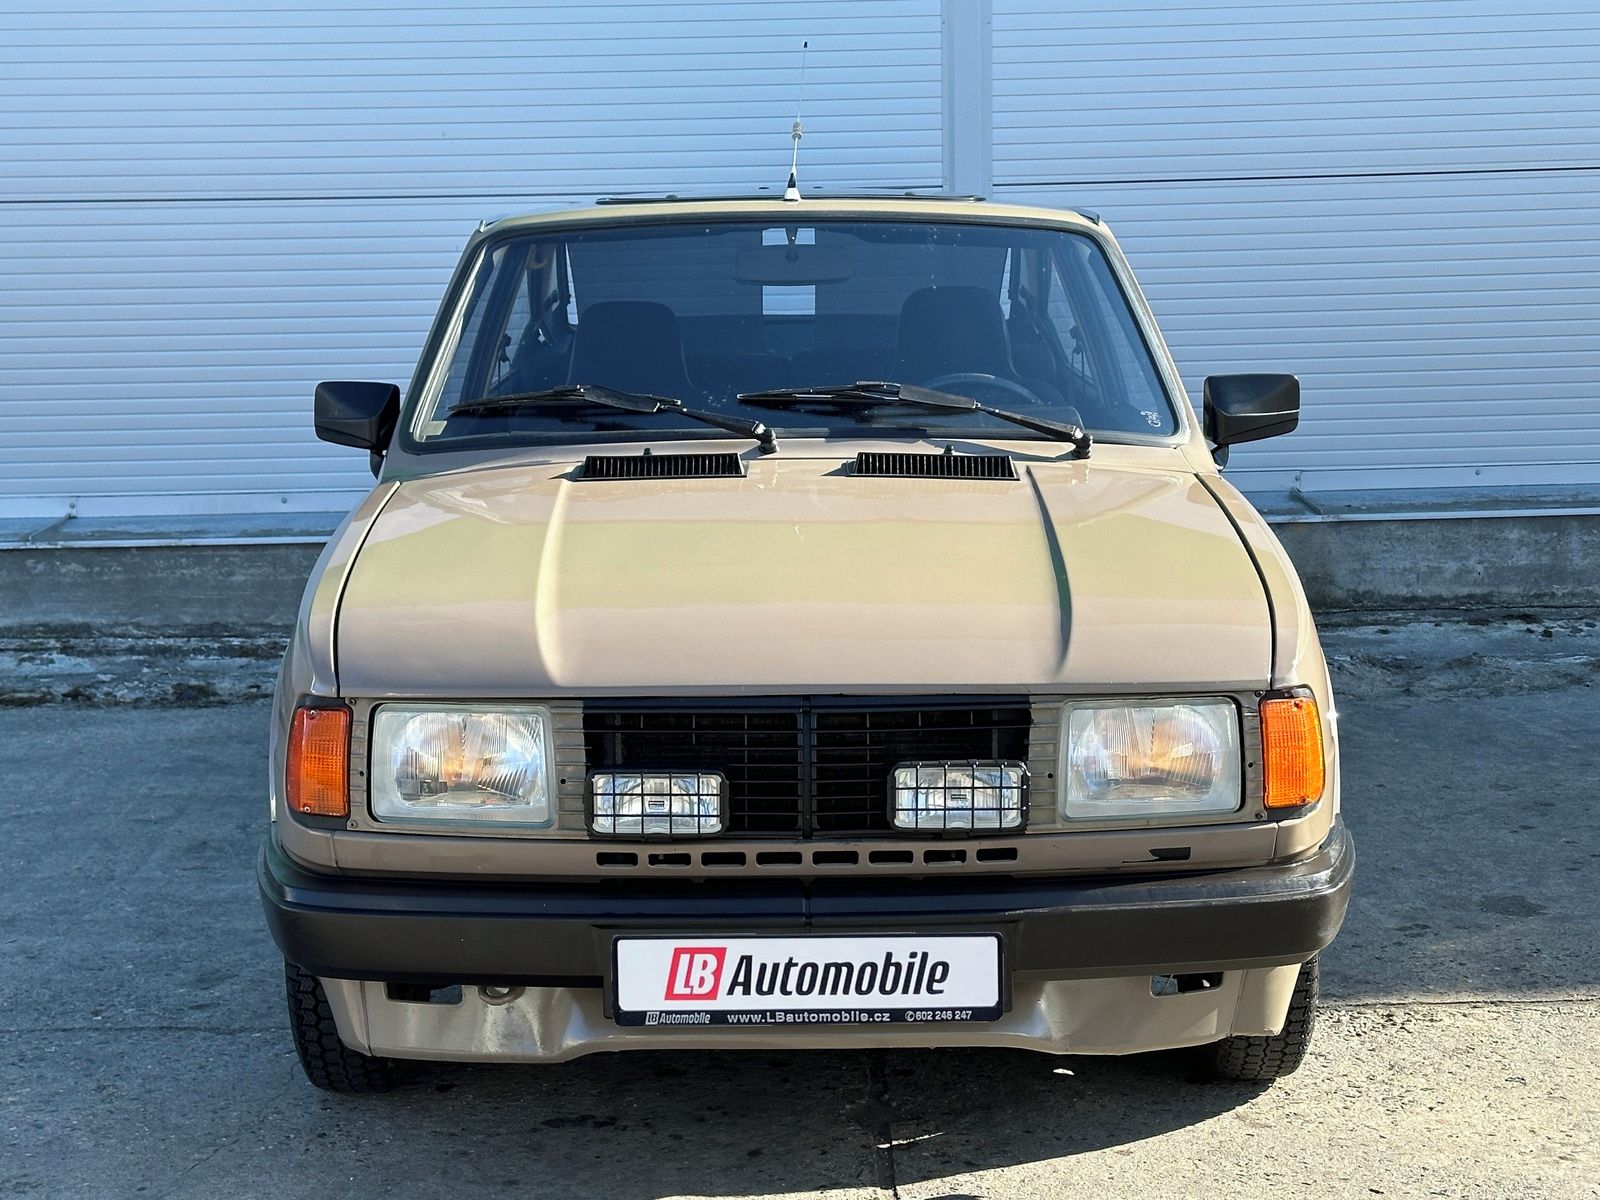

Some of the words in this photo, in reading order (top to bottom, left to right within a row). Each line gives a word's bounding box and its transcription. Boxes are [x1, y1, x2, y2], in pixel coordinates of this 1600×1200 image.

[671, 952, 719, 996] LB
[726, 950, 950, 997] Automobile
[659, 1012, 711, 1024] Automobile
[727, 1011, 891, 1023] www.LBautomobile.cz
[915, 1010, 933, 1021] 602
[954, 1010, 972, 1020] 247
